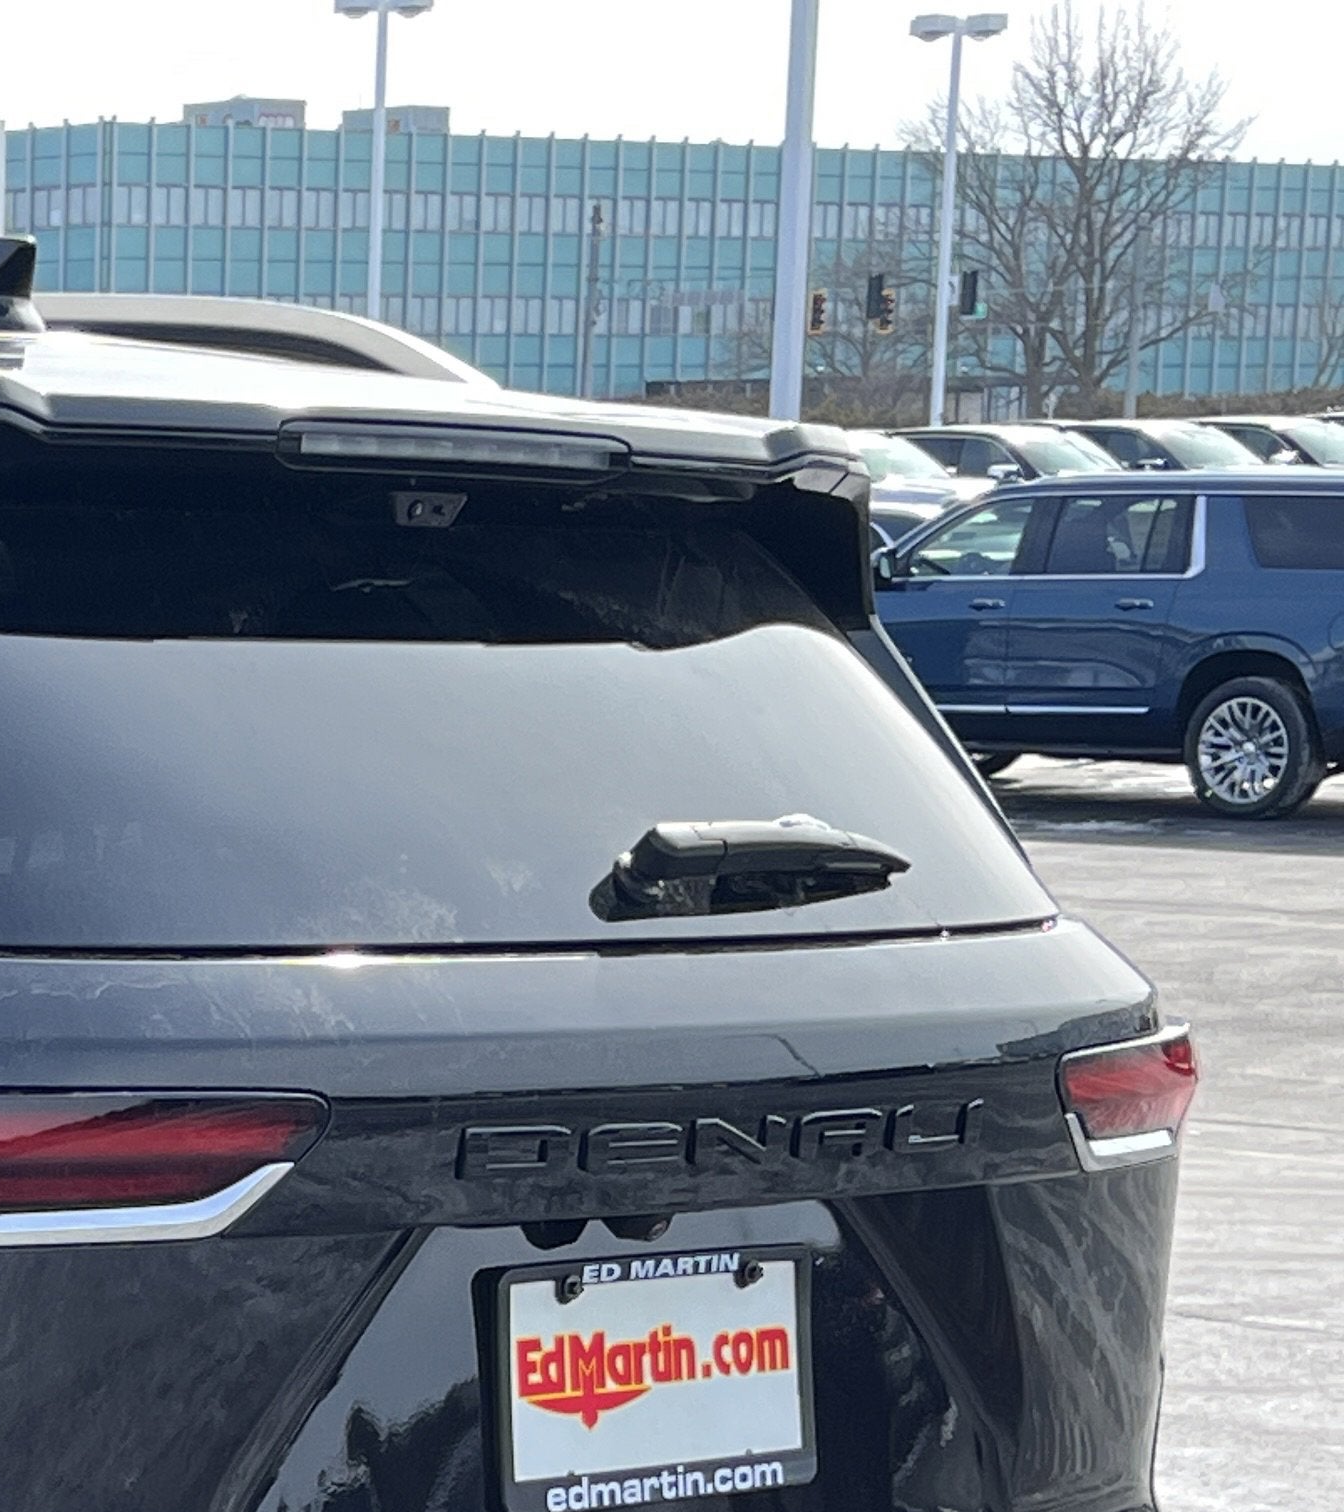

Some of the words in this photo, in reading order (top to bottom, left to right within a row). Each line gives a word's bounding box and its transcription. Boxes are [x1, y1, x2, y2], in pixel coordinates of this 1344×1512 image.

[454, 1098, 983, 1181] DENALI
[582, 1262, 622, 1284] ED
[629, 1252, 740, 1280] MARTIN
[516, 1324, 791, 1398] EdMartin.com
[546, 1460, 784, 1512] edmartin.com
